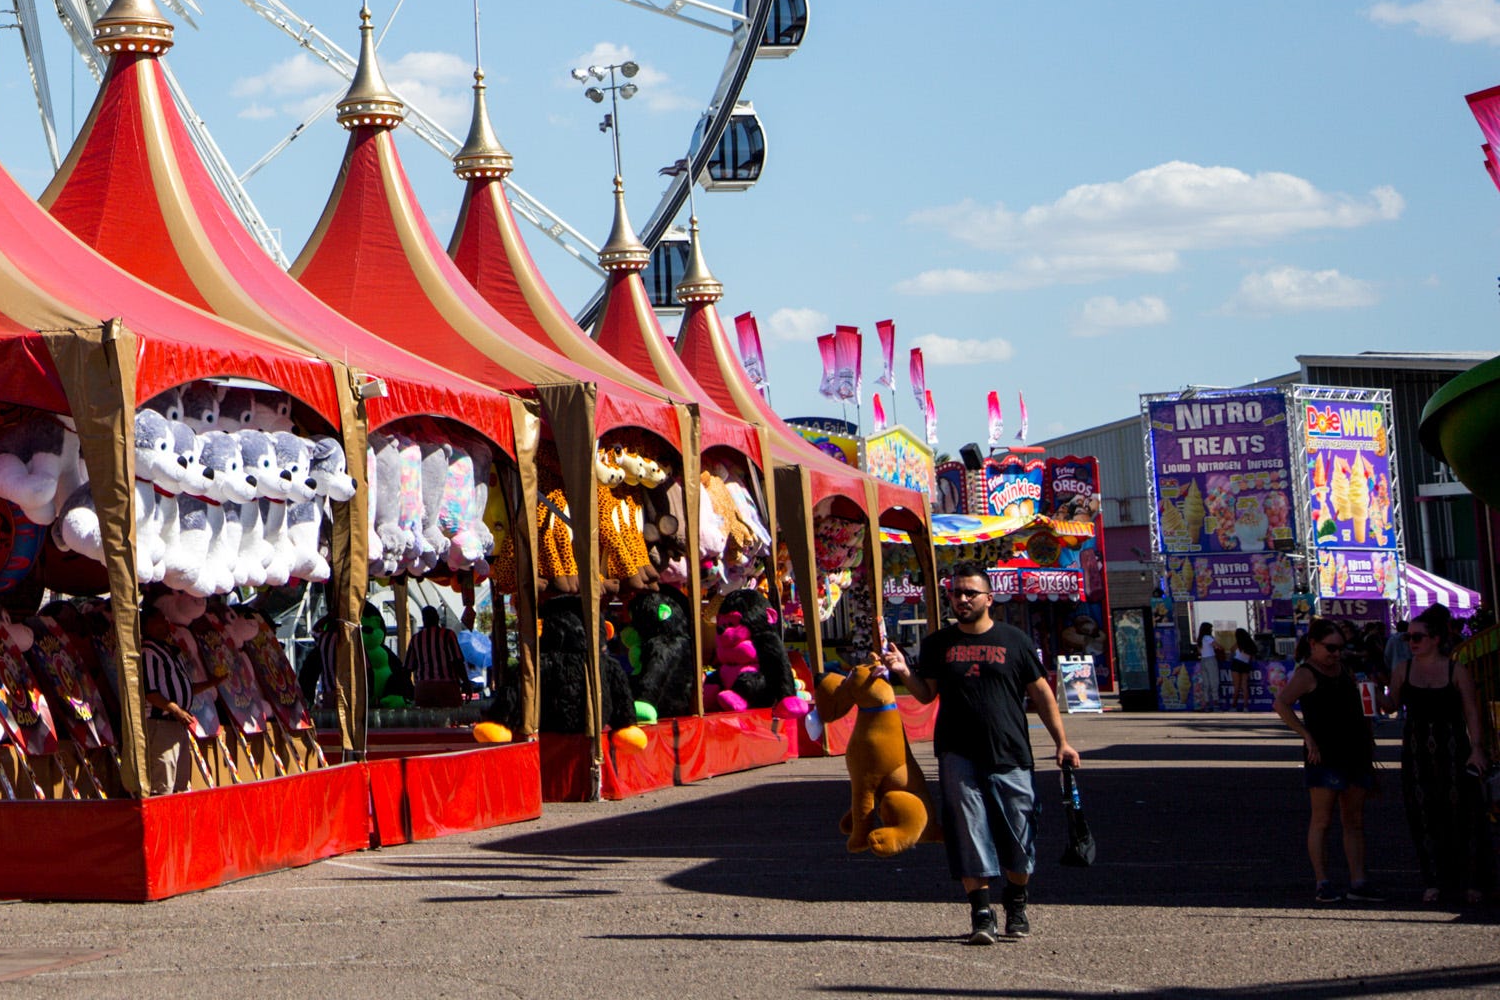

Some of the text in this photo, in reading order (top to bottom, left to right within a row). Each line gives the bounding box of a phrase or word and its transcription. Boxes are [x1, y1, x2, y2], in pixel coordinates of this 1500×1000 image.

[1174, 401, 1263, 431] NITRO
[1306, 405, 1383, 437] Dole WHIP
[1177, 434, 1266, 460] TREATS
[1055, 466, 1075, 476] Fried
[1162, 458, 1284, 474] LIQUID NITROGEN INFUSED
[989, 477, 1041, 514] Twinkies
[1052, 478, 1093, 497] OREOS
[1213, 563, 1249, 575] NITRO
[1347, 559, 1371, 572] NITRO
[1040, 575, 1078, 592] OREOS
[1215, 577, 1251, 588] TREATS
[1349, 574, 1374, 585] TREATS
